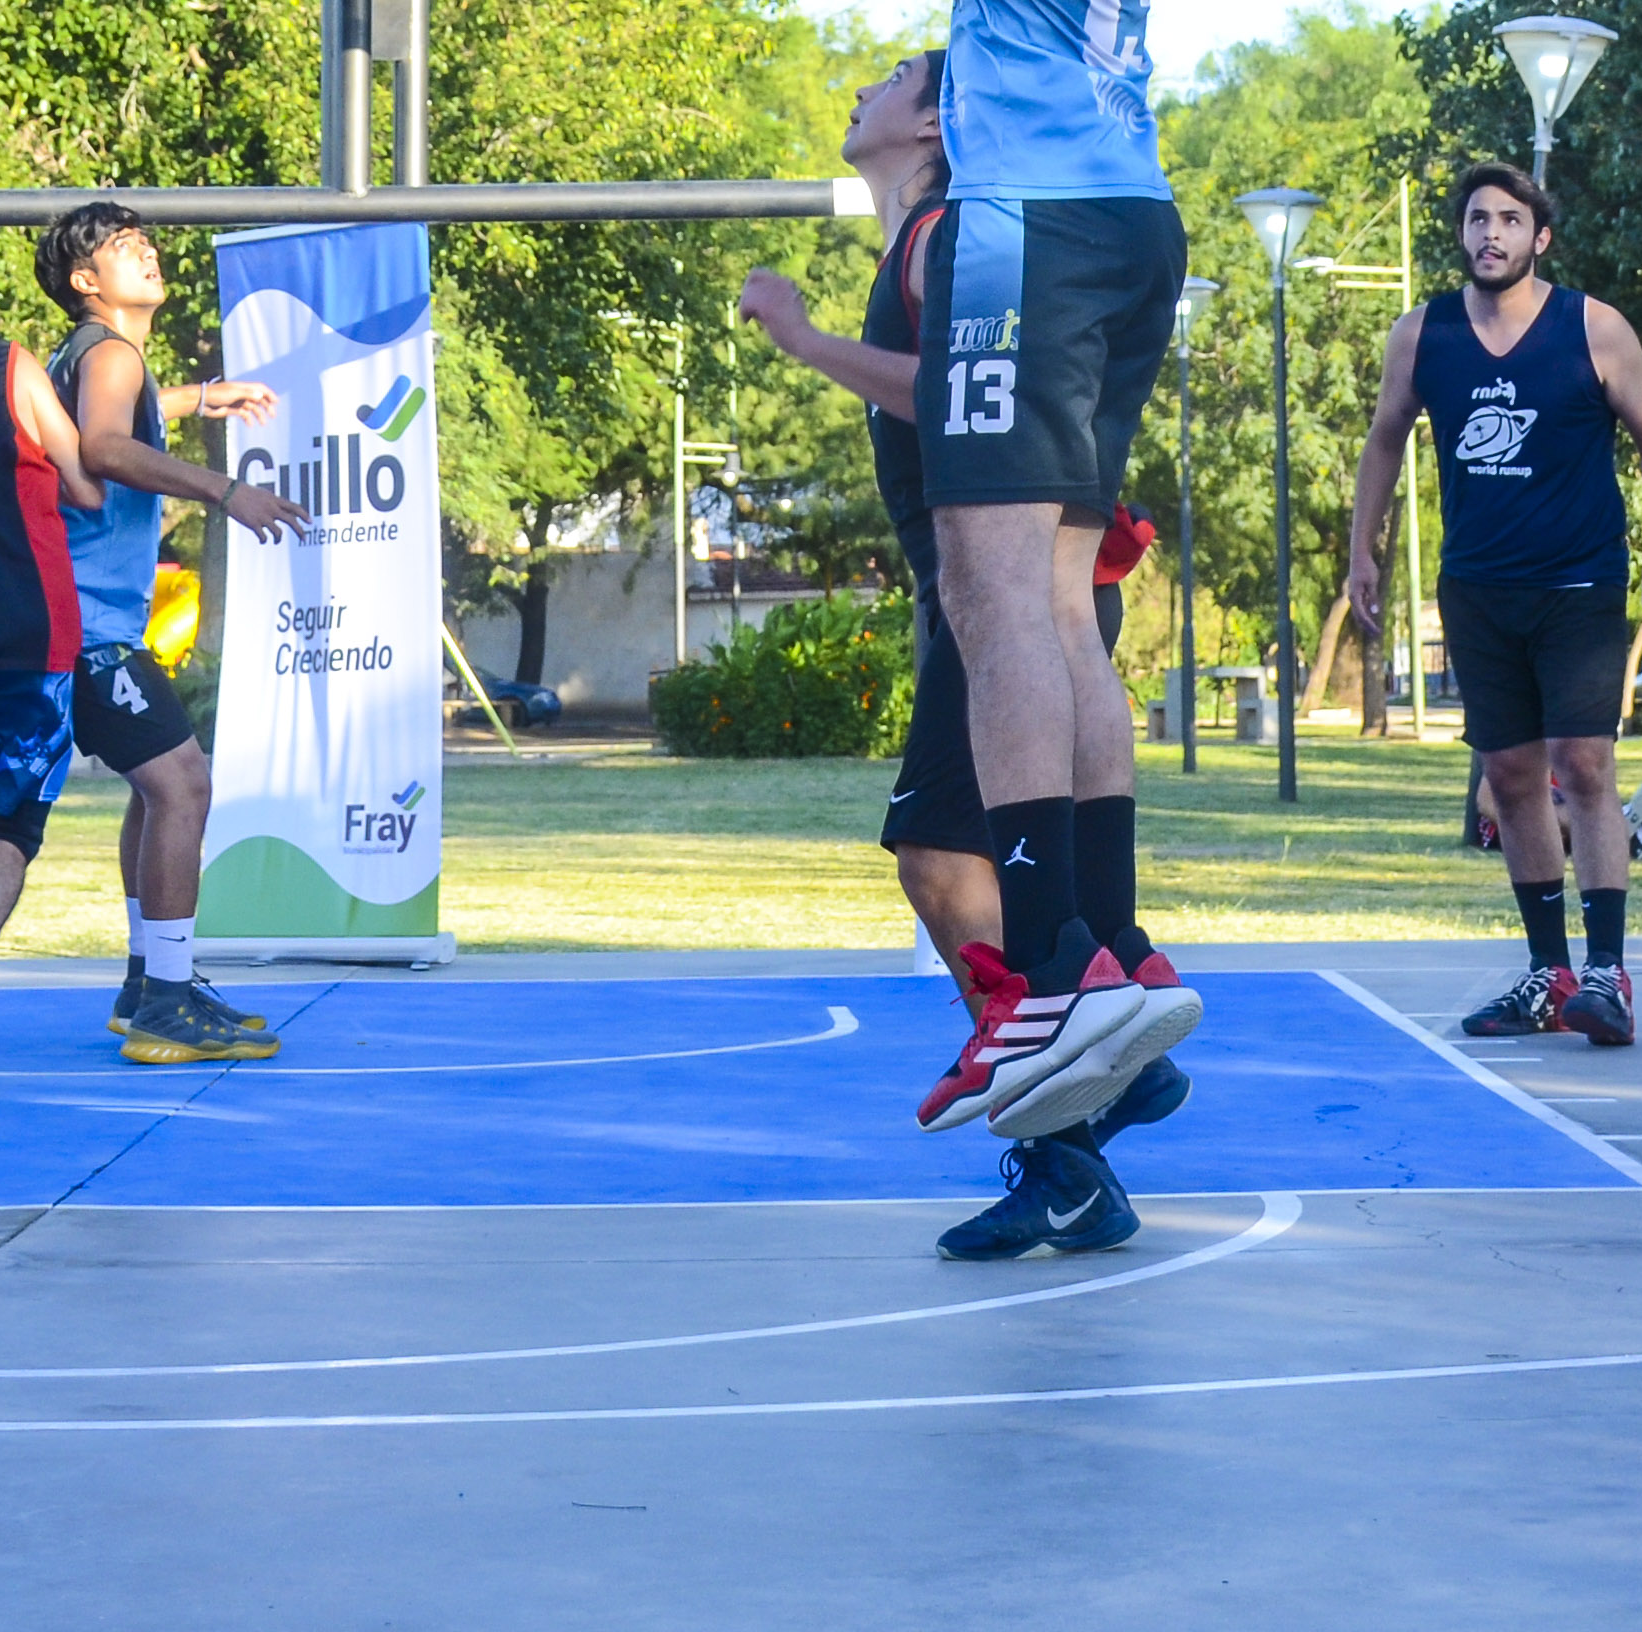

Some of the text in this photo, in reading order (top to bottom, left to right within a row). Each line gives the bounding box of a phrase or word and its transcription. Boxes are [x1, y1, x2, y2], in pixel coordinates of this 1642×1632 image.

[945, 360, 1017, 435] 13
[276, 595, 347, 641] Seguir
[275, 635, 393, 675] Creciendo
[112, 666, 149, 715] 4
[344, 804, 417, 854] Fray
